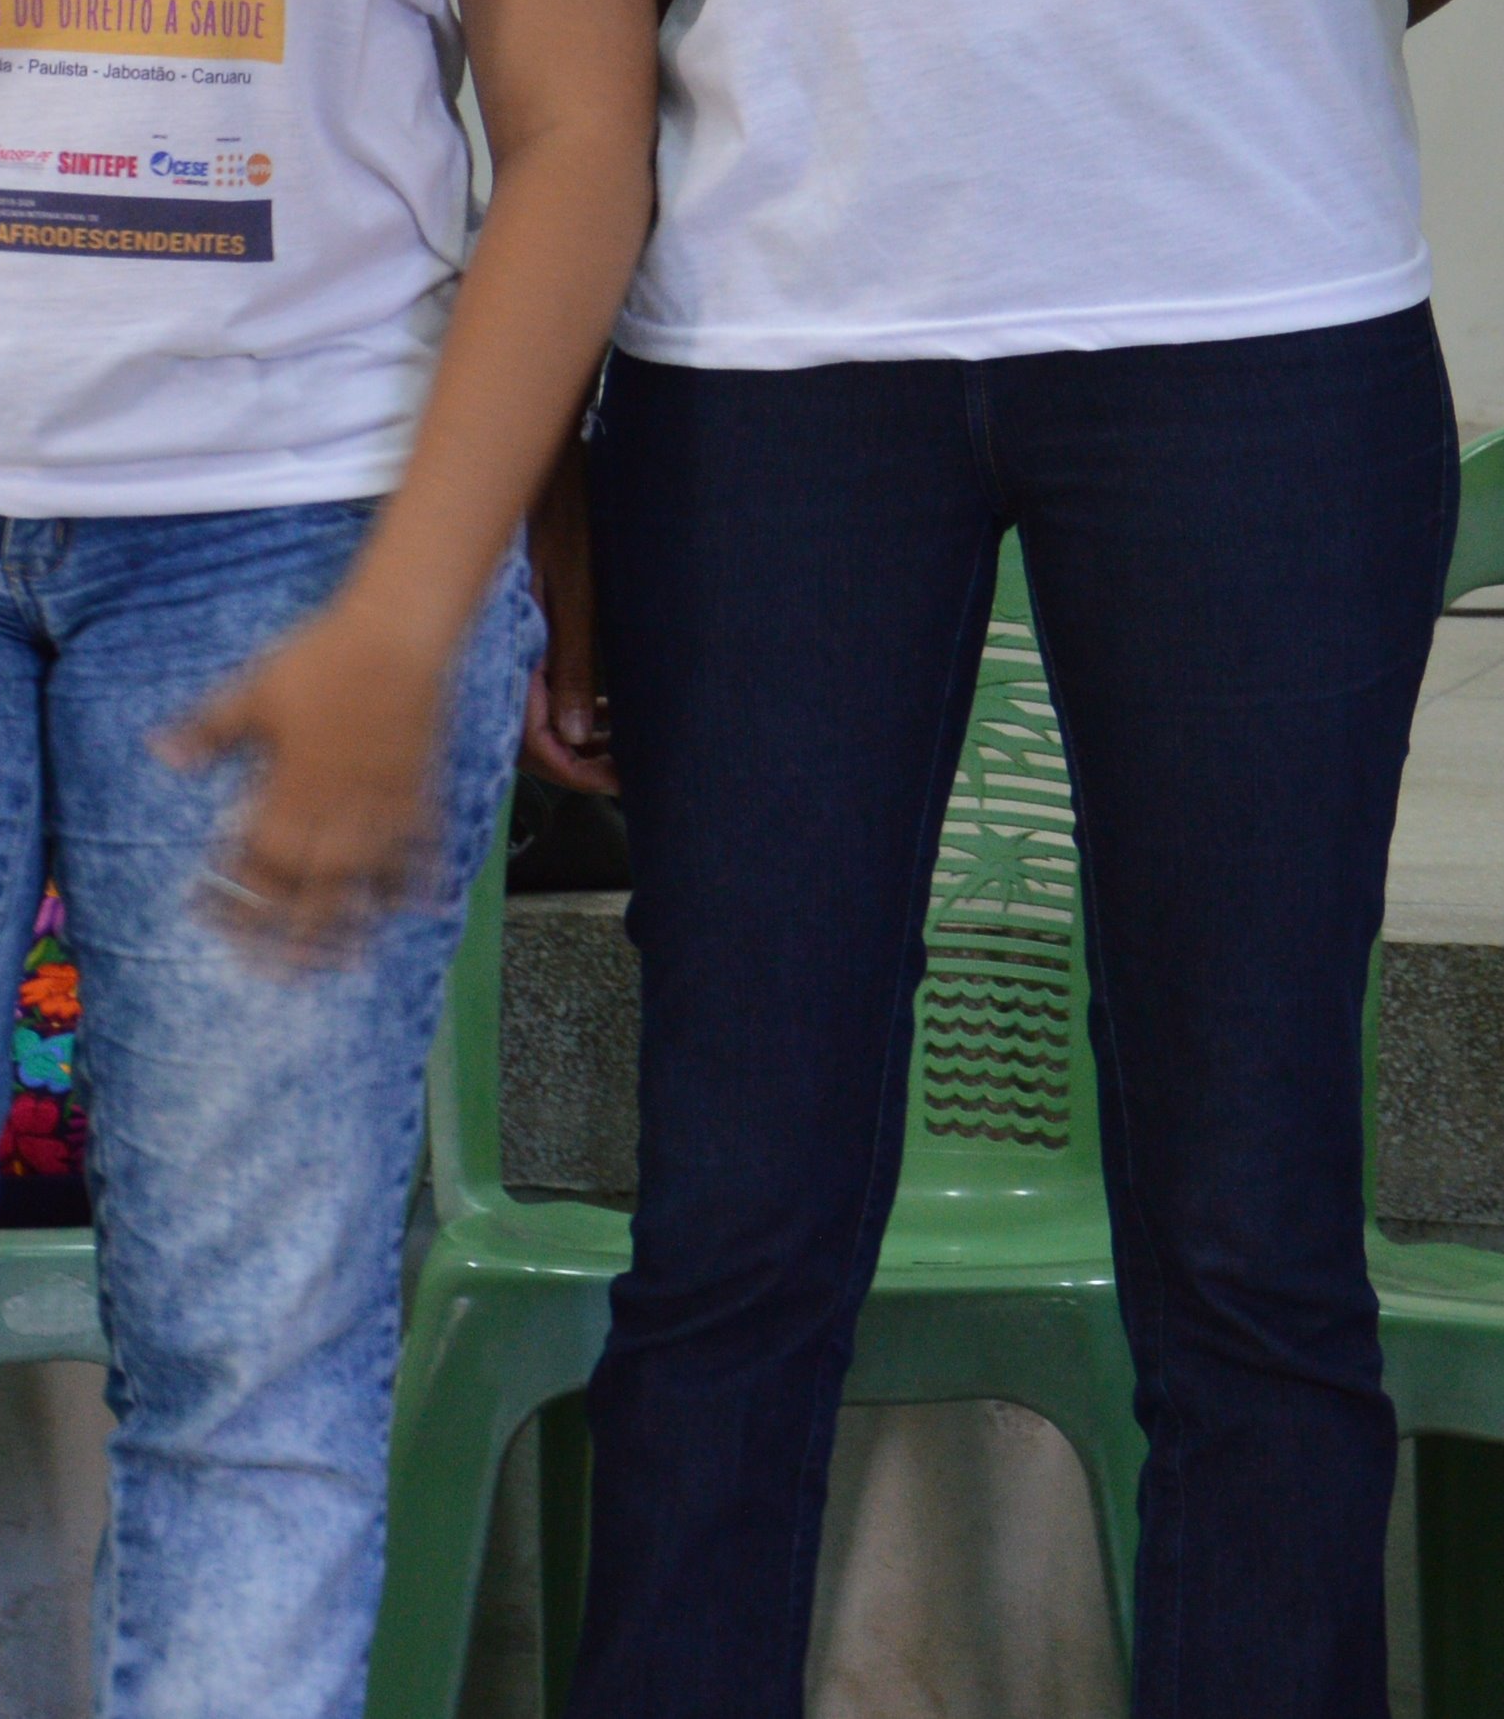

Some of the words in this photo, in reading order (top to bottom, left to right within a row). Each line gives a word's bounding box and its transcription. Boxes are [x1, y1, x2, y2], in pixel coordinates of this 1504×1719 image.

[28, 58, 88, 78] Paulista
[103, 64, 176, 83] Jaboatão
[191, 68, 252, 85] Caruaru
[57, 150, 139, 179] SINTEPE
[172, 159, 210, 177] CESE
